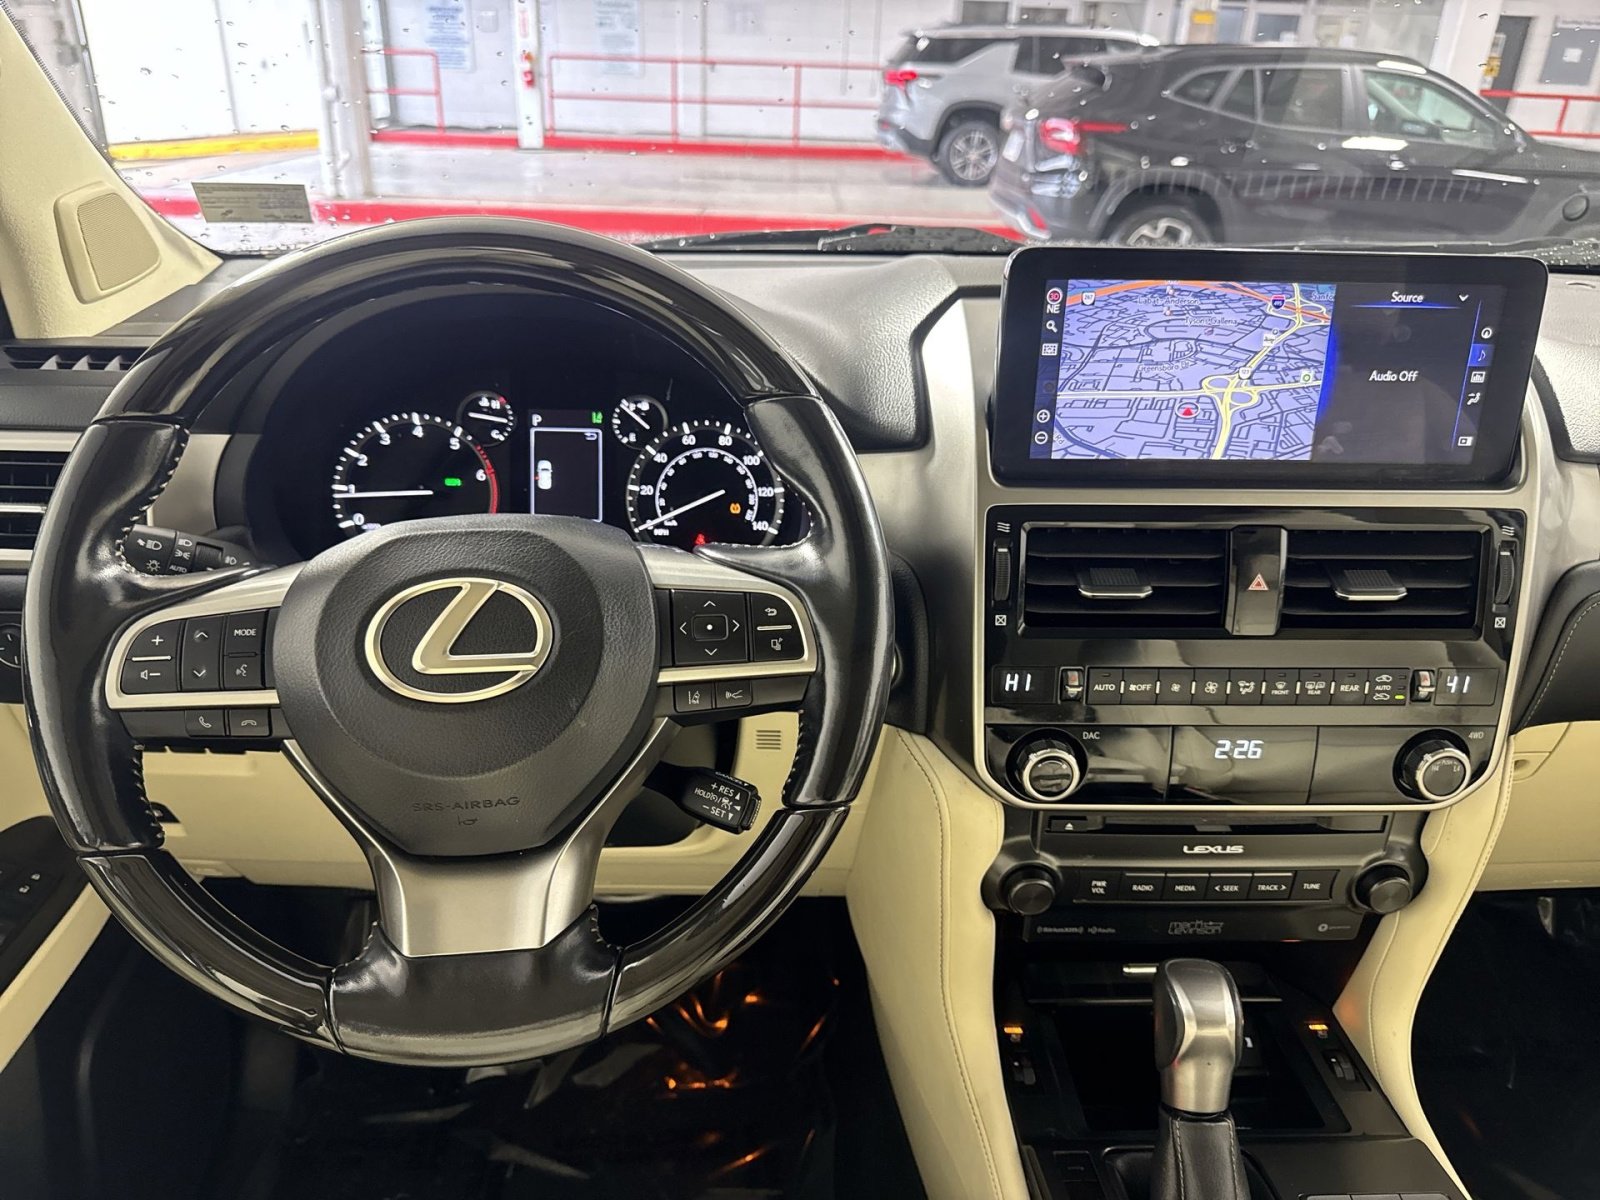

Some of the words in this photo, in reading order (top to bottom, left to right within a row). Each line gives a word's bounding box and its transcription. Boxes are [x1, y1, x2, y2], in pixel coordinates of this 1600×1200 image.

[1391, 291, 1424, 303] Source
[1046, 304, 1060, 314] NE
[1369, 370, 1398, 382] Audio
[1399, 370, 1419, 382] Off
[532, 414, 542, 426] P
[413, 426, 424, 438] 4
[380, 433, 391, 445] 3
[450, 437, 460, 450] 5
[681, 434, 697, 446] 60
[718, 435, 733, 446] 80
[358, 454, 368, 466] 2
[653, 452, 668, 463] 40
[743, 455, 761, 466] 100
[476, 469, 486, 481] 6
[639, 485, 654, 495] 20
[757, 487, 775, 498] 120
[354, 513, 365, 525] 0
[752, 520, 769, 531] 140
[169, 564, 187, 573] AUTO
[1093, 684, 1116, 692] AUTO
[1136, 684, 1151, 692] OFF
[1340, 684, 1360, 692] REAR
[1446, 675, 1471, 694] 41
[1082, 731, 1100, 740] DAC
[1468, 731, 1484, 739] 4WD
[694, 787, 711, 799] HOLD
[718, 785, 735, 797] RES
[710, 806, 727, 818] SET
[1183, 845, 1244, 854] LEXUS
[1091, 880, 1107, 888] PWR
[1132, 884, 1154, 893] RADIO
[1175, 884, 1196, 892] MEDIA
[1222, 884, 1239, 892] SEEK
[1257, 883, 1278, 892] TRACK
[1303, 883, 1320, 891] TUNE
[1091, 887, 1105, 895] VOL
